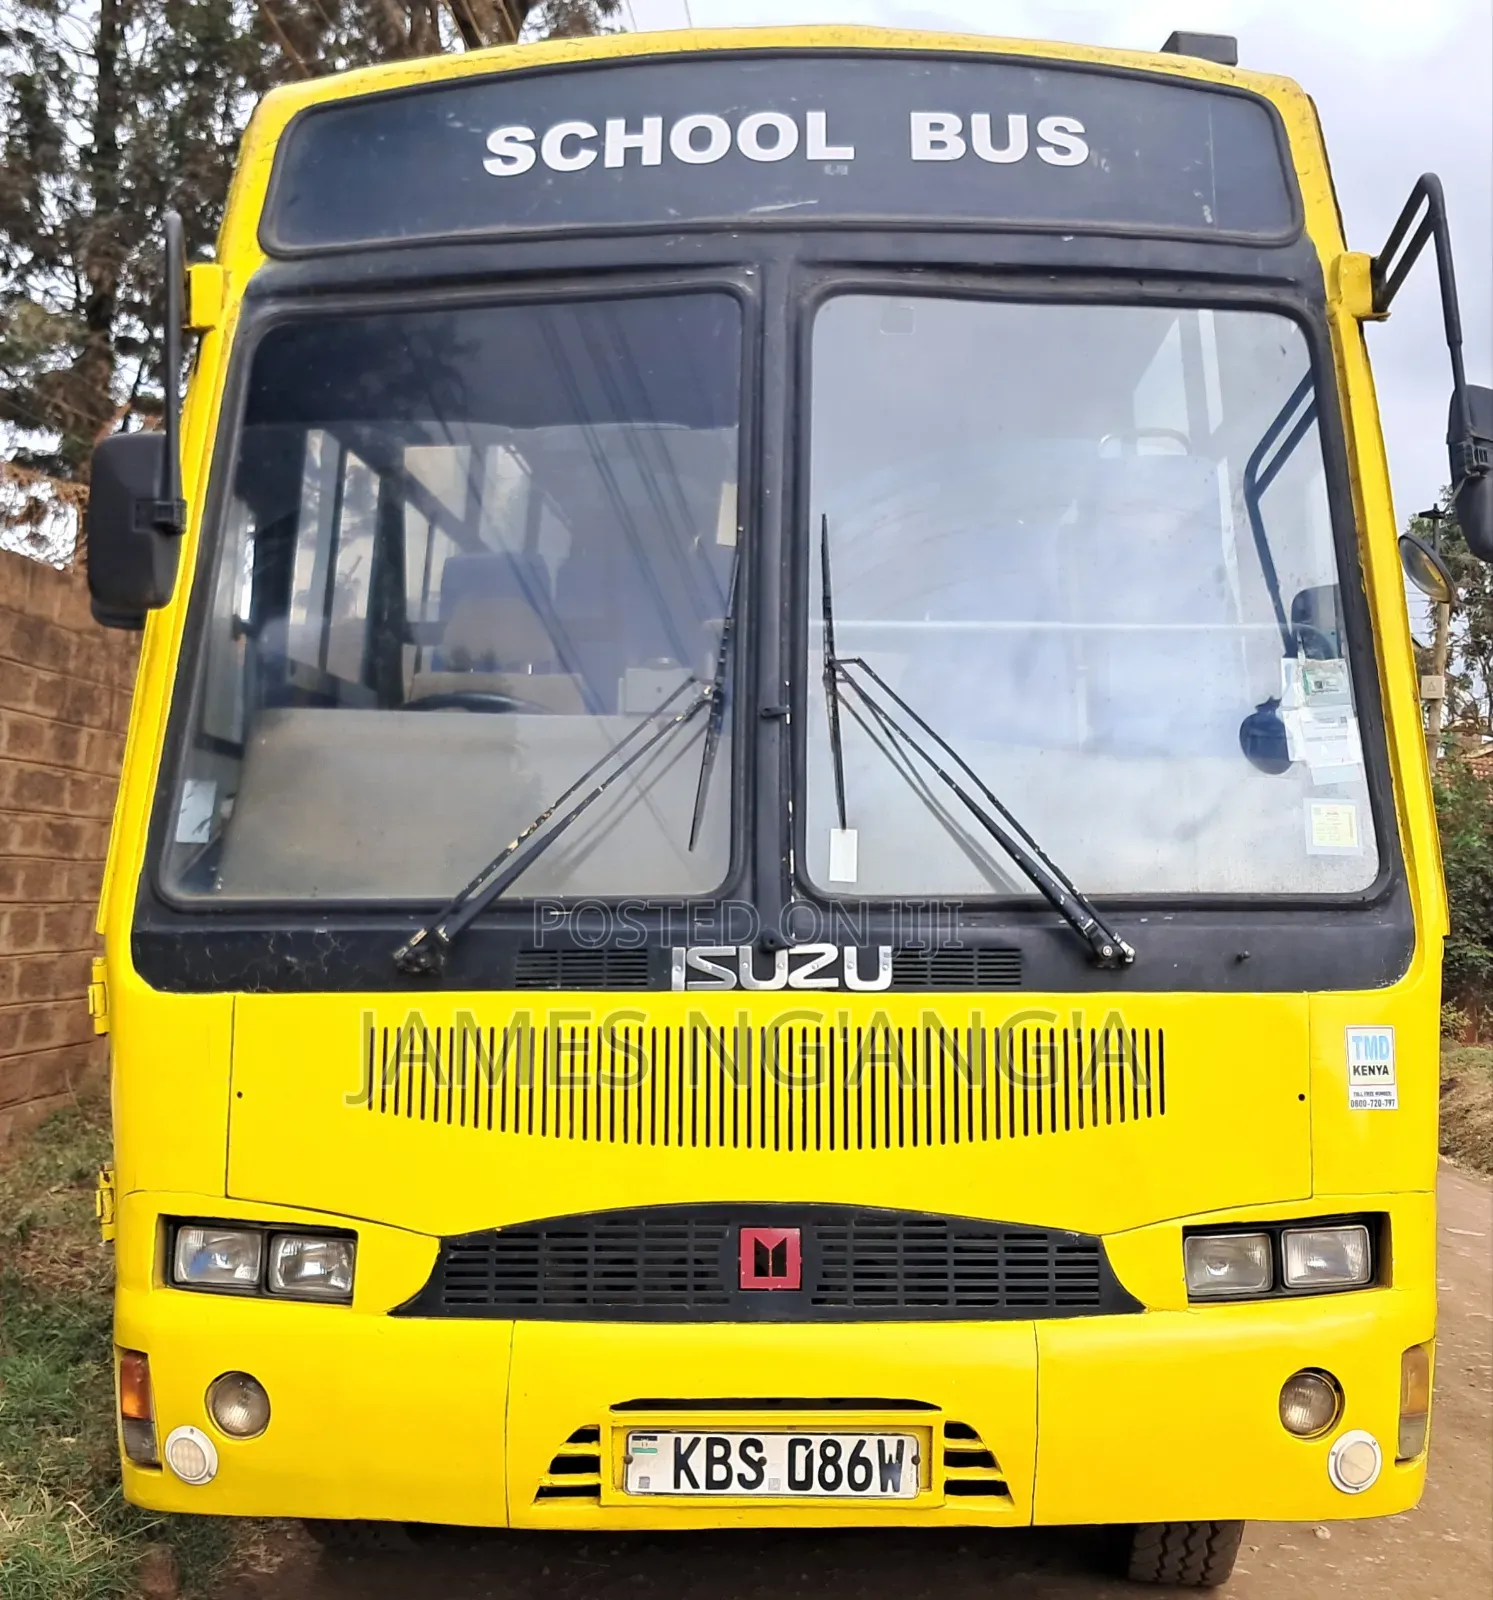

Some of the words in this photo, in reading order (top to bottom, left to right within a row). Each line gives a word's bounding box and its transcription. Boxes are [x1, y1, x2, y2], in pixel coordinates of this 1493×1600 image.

[482, 111, 856, 177] SCHOOL
[910, 111, 1090, 167] BUS
[672, 943, 893, 992] ISUZU
[1351, 1035, 1390, 1061] TMD
[1353, 1065, 1390, 1076] KENYA
[673, 1436, 766, 1491] KBS
[787, 1438, 905, 1493] 086W
